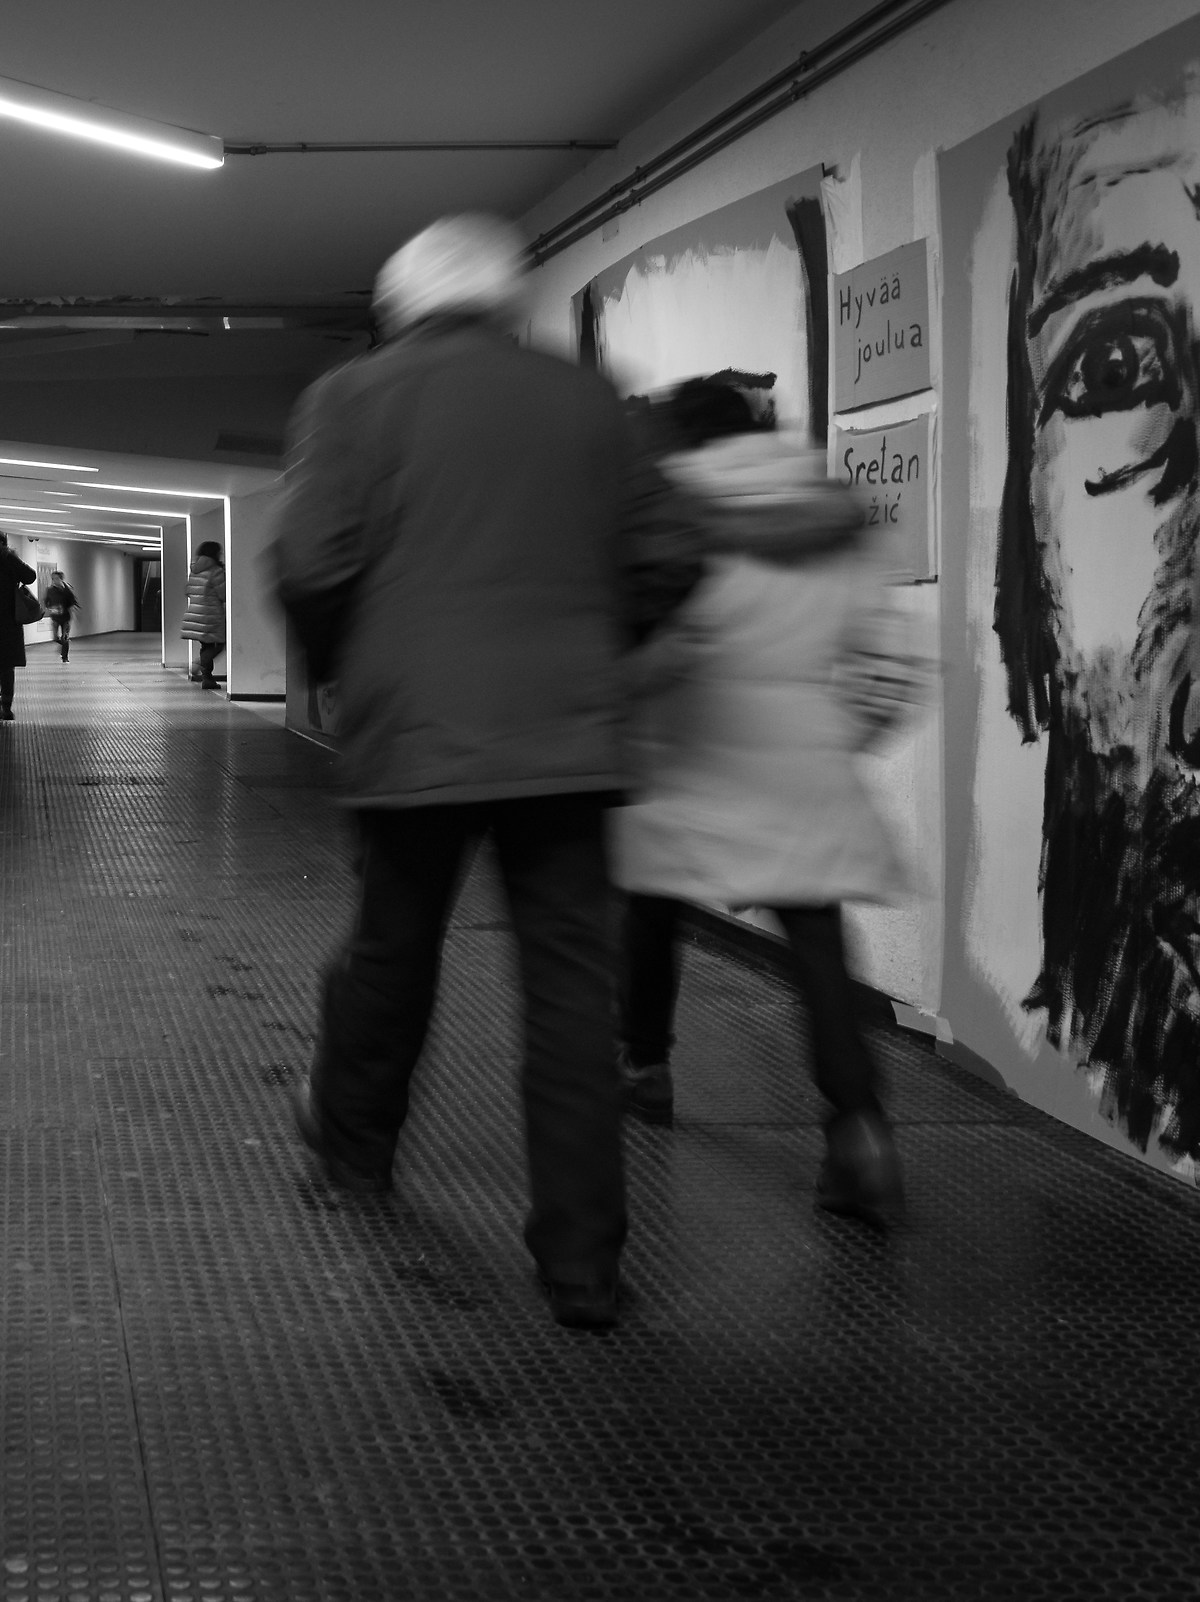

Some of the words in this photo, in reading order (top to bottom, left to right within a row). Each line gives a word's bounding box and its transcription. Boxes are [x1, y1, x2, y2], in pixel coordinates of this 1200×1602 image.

[839, 273, 901, 328] Hyvää
[854, 319, 923, 384] joulua
[843, 436, 920, 488] Sretan
[868, 494, 901, 526] žić
